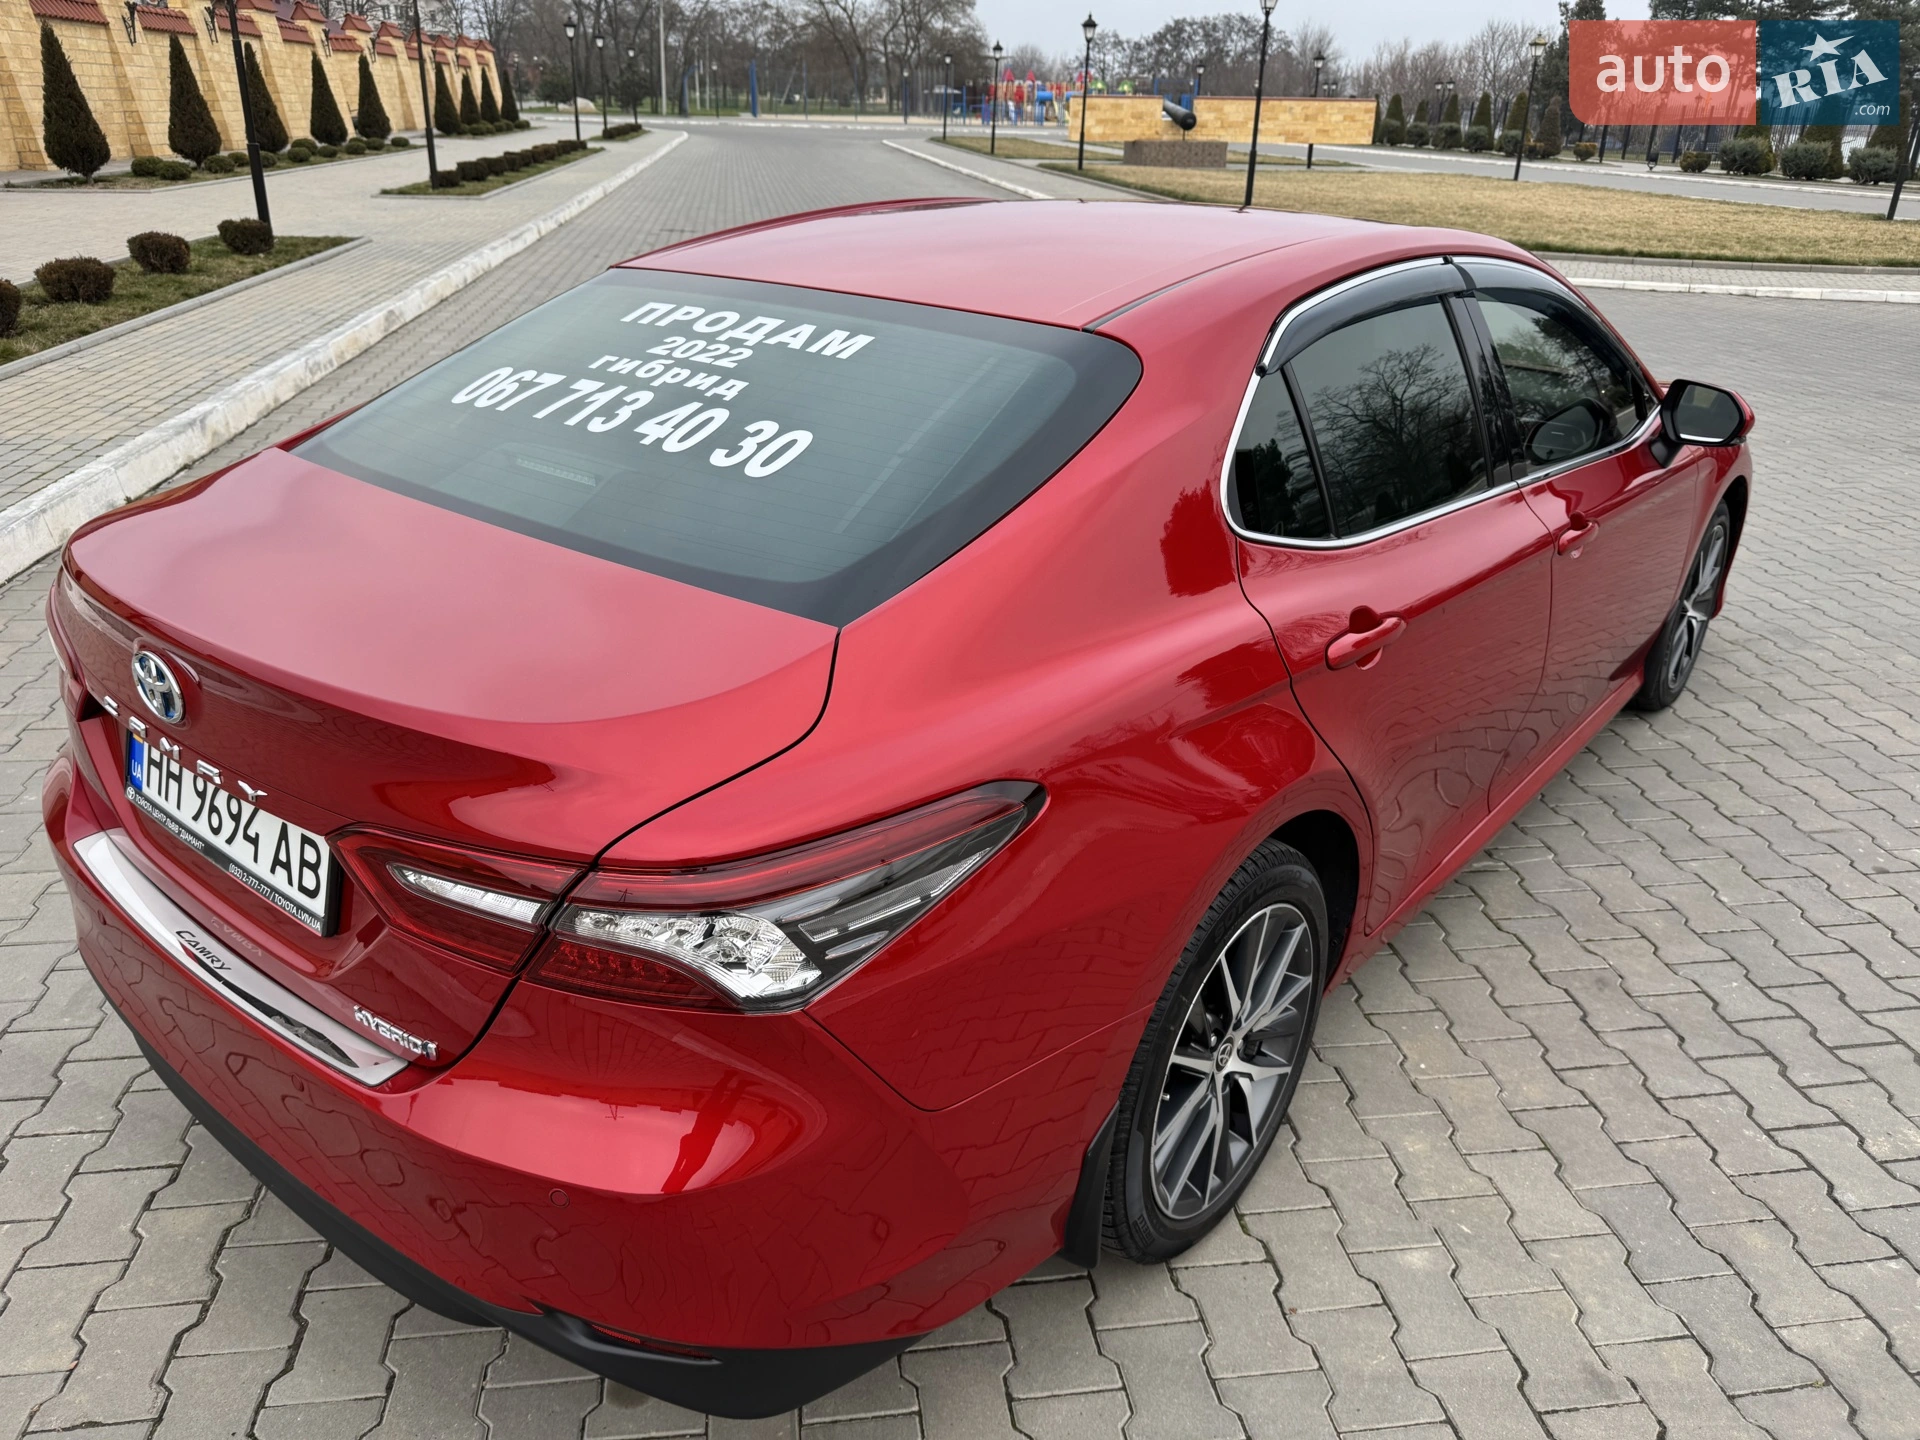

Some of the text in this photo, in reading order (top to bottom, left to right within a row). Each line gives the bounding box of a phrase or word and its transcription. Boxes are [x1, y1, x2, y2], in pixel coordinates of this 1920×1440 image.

[620, 301, 875, 360] ПРОДАМ
[646, 336, 753, 368] 2022
[588, 354, 749, 401] гибрид
[451, 366, 813, 478] 067 713 40 30
[131, 759, 143, 781] UA
[135, 794, 153, 813] ТОЙОТА
[152, 807, 167, 822] ЦЕНТР
[146, 744, 322, 900] HH 9694 AB
[228, 862, 243, 880] (032)
[274, 893, 321, 931] TOYOTA.LVIV.UA
[175, 930, 232, 971] CAMRY
[353, 1004, 437, 1061] HYBRID
